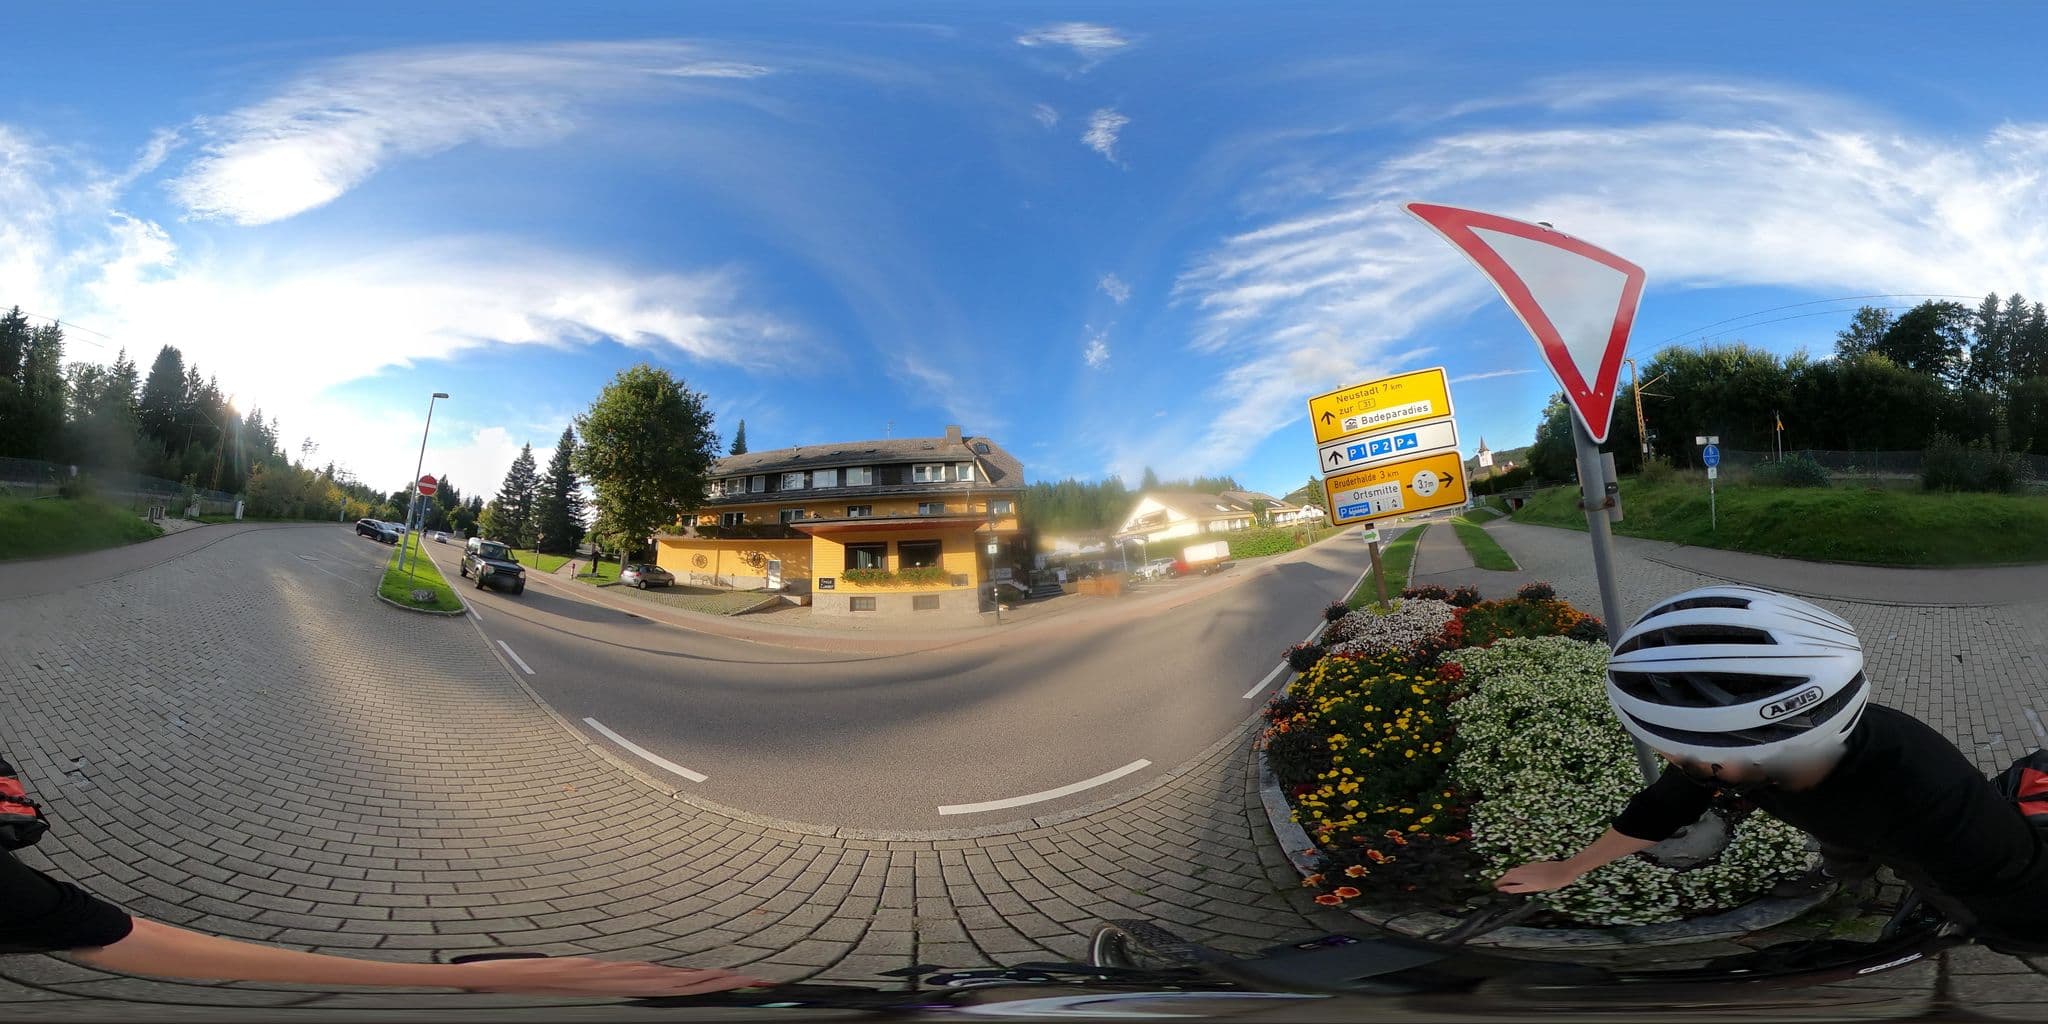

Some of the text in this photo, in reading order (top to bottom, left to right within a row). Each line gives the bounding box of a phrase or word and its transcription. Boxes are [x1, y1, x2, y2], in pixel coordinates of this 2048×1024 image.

[1336, 383, 1403, 404] Neustadt 7 km
[1339, 400, 1372, 415] zur 31
[1361, 404, 1429, 425] Badeparadies
[1397, 438, 1404, 447] P
[1334, 470, 1400, 489] Bruderhalde 3 km
[1353, 485, 1398, 500] Ortsmitte
